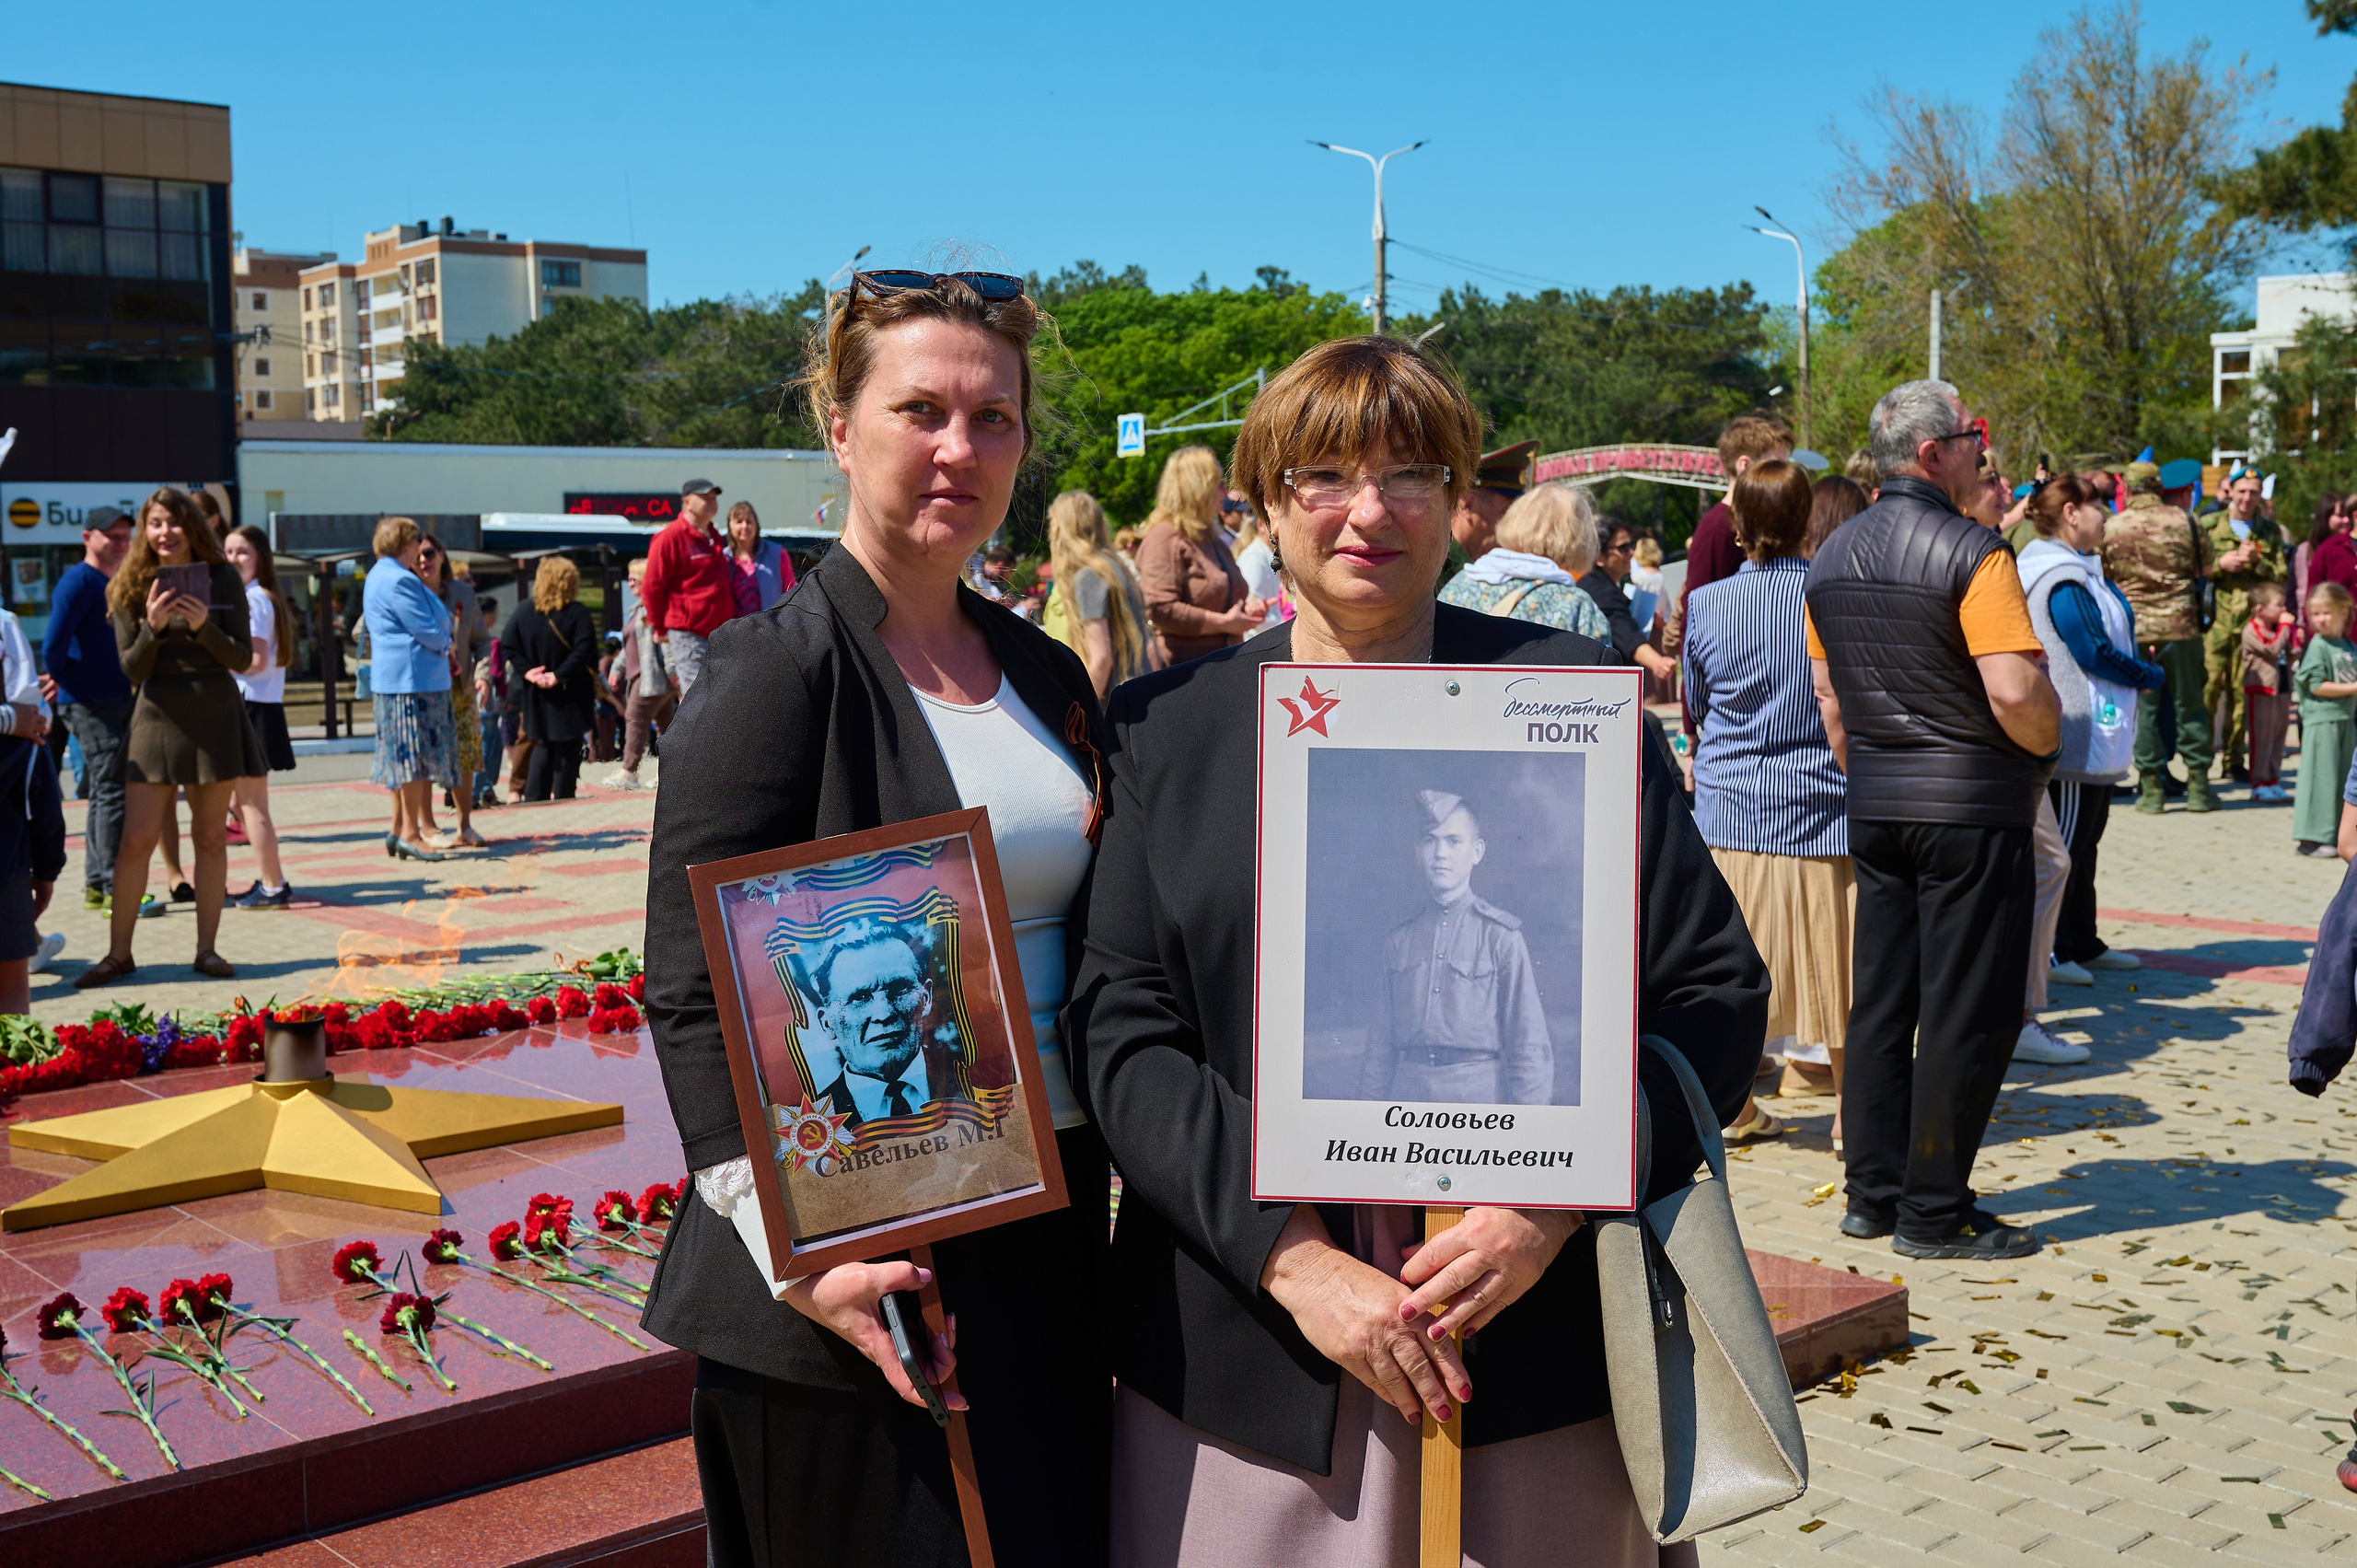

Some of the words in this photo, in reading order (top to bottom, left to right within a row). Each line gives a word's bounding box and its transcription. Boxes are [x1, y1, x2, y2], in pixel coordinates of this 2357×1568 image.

[568, 498, 673, 517] АВТОКАССА
[1527, 722, 1600, 744] ПОЛК
[1384, 1105, 1515, 1131] Соловьев
[815, 1134, 949, 1178] Савельев
[1324, 1139, 1398, 1163] Иван
[1404, 1142, 1574, 1168] Васильевич
